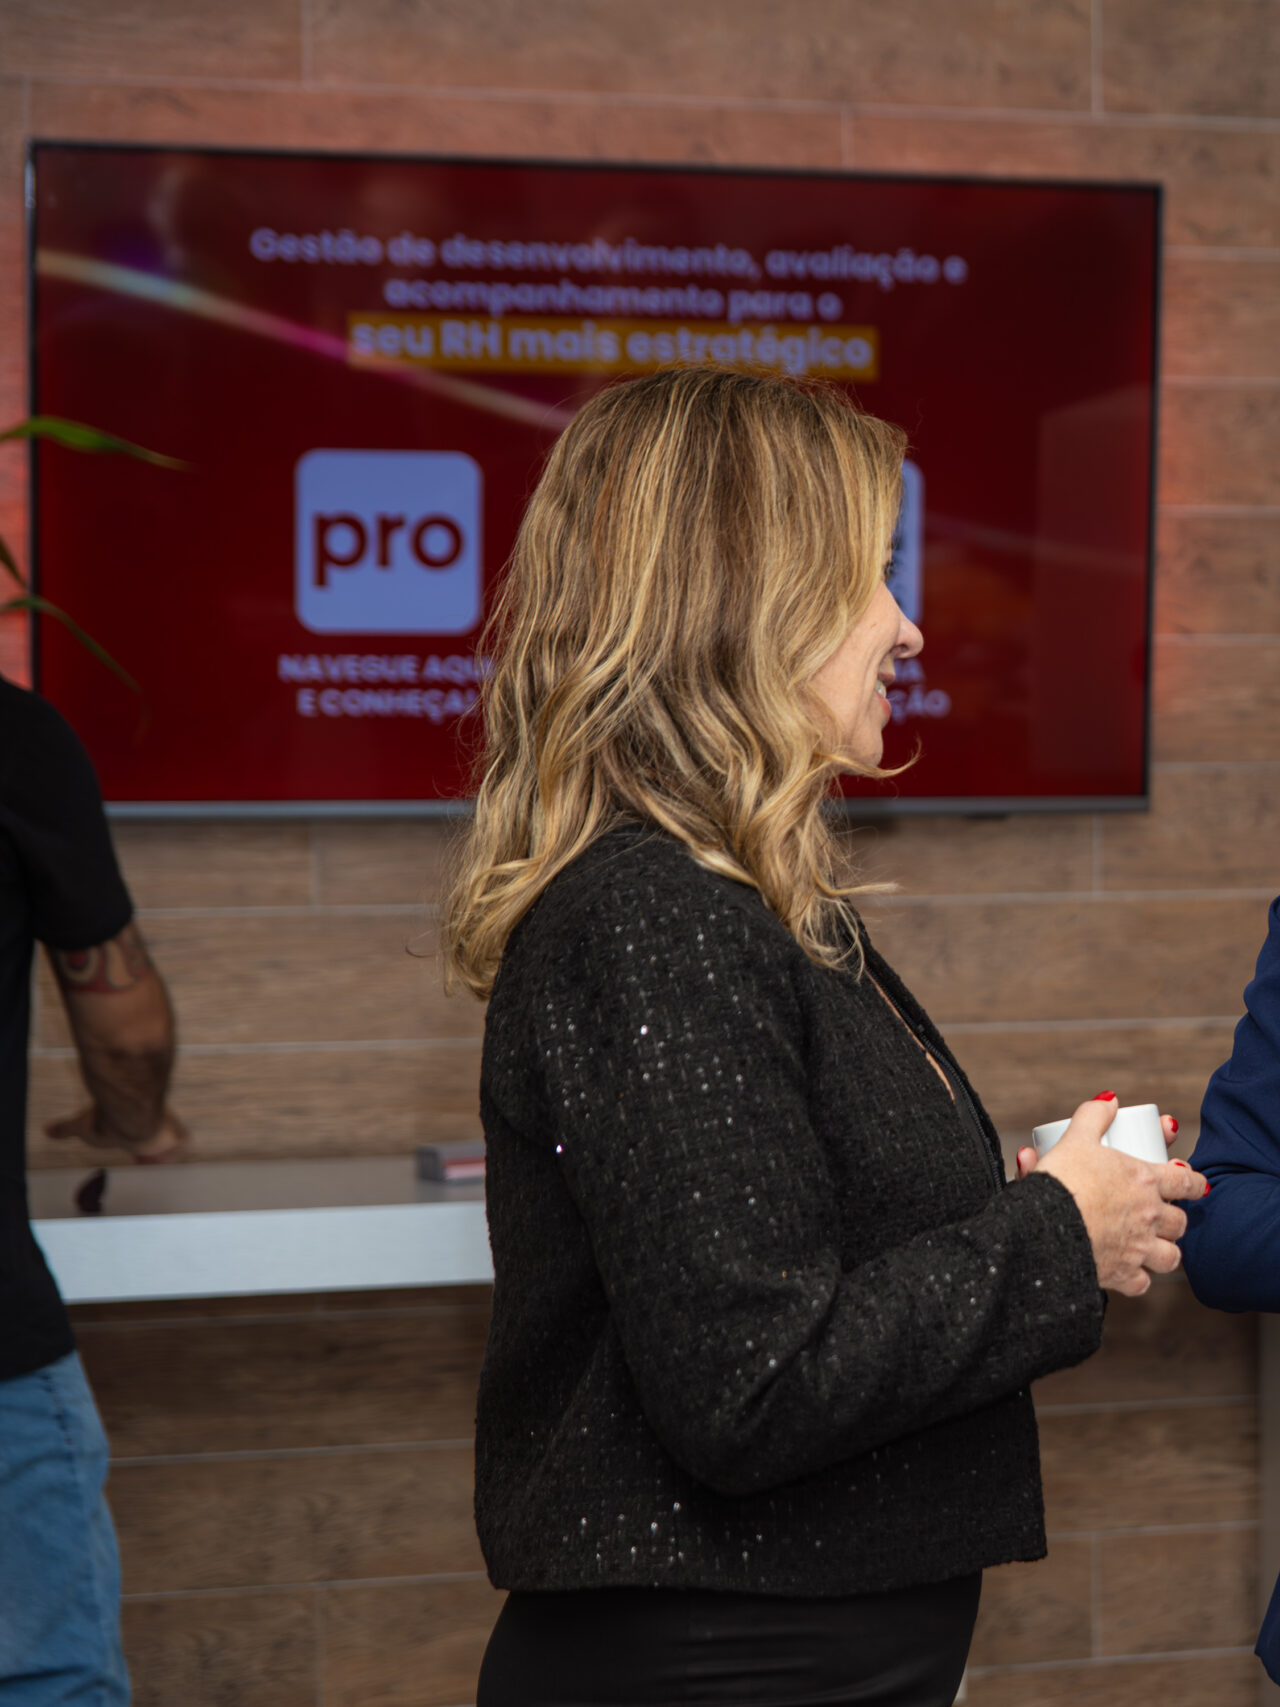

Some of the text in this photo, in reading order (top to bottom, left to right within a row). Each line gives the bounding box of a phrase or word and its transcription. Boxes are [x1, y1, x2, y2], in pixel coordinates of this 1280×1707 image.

[250, 227, 969, 291] Gestão de desenvolvimento, avaliação e
[384, 277, 844, 327] acompanhamento para o
[352, 318, 874, 379] seu RH mais estratégico
[313, 510, 465, 590] pro
[277, 653, 419, 683] NAVEGUE
[296, 687, 316, 717] E
